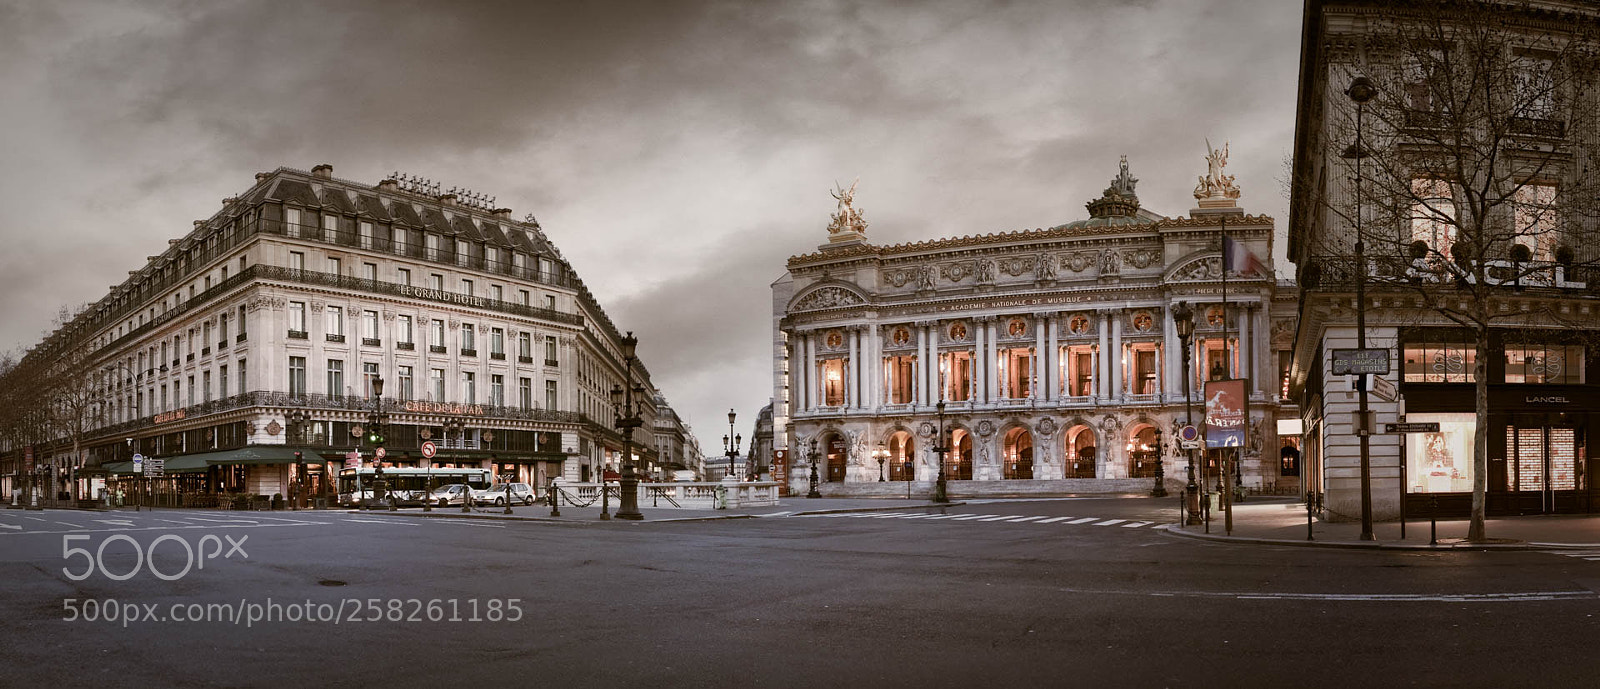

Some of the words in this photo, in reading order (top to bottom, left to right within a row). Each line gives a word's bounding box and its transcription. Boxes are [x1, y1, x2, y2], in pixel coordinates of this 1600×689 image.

[401, 285, 411, 295] LE
[414, 287, 450, 301] GRAND
[950, 302, 986, 311] ACADEMIE
[991, 300, 1027, 308] NATIONALE
[1048, 296, 1081, 304] MUSIQUE
